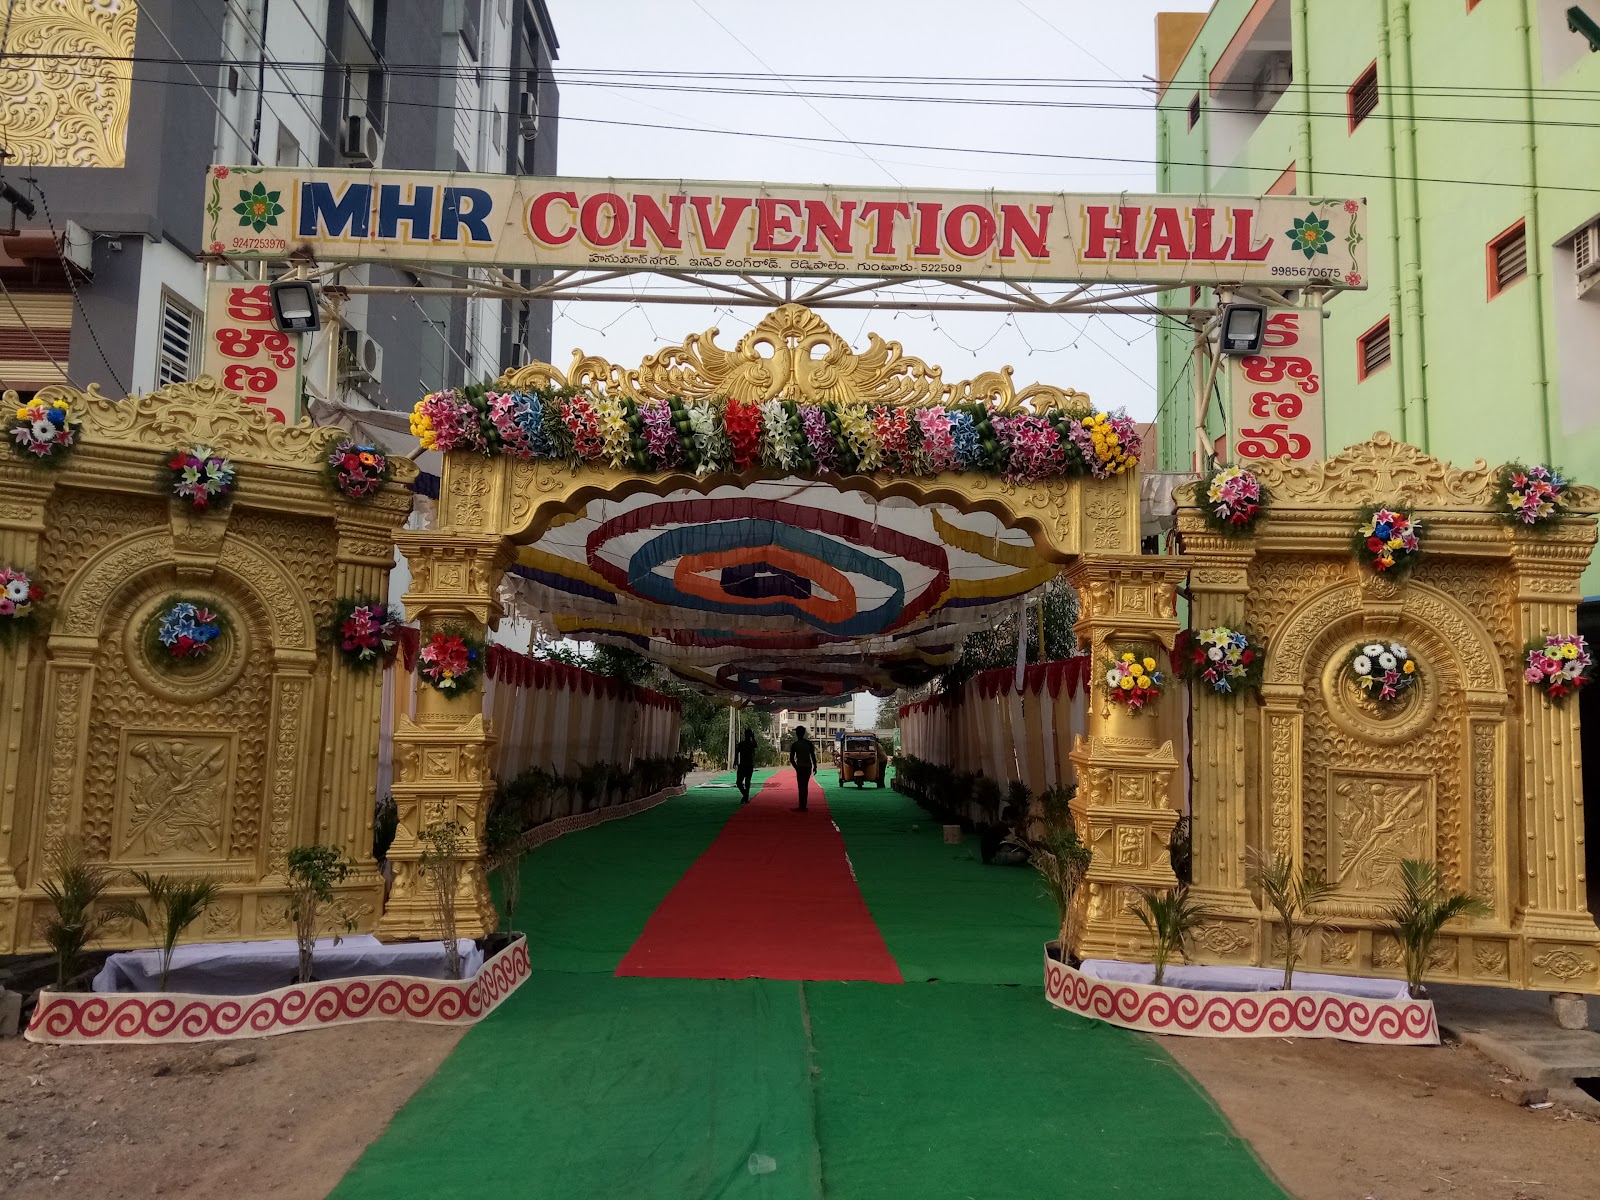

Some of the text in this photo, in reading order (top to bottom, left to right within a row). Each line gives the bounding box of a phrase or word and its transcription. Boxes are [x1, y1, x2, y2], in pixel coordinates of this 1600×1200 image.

[530, 191, 1054, 258] CONVENTION
[1084, 206, 1275, 262] HALL
[232, 237, 286, 249] 9247253970
[920, 263, 962, 272] 522509
[1271, 266, 1341, 278] 9985670675
